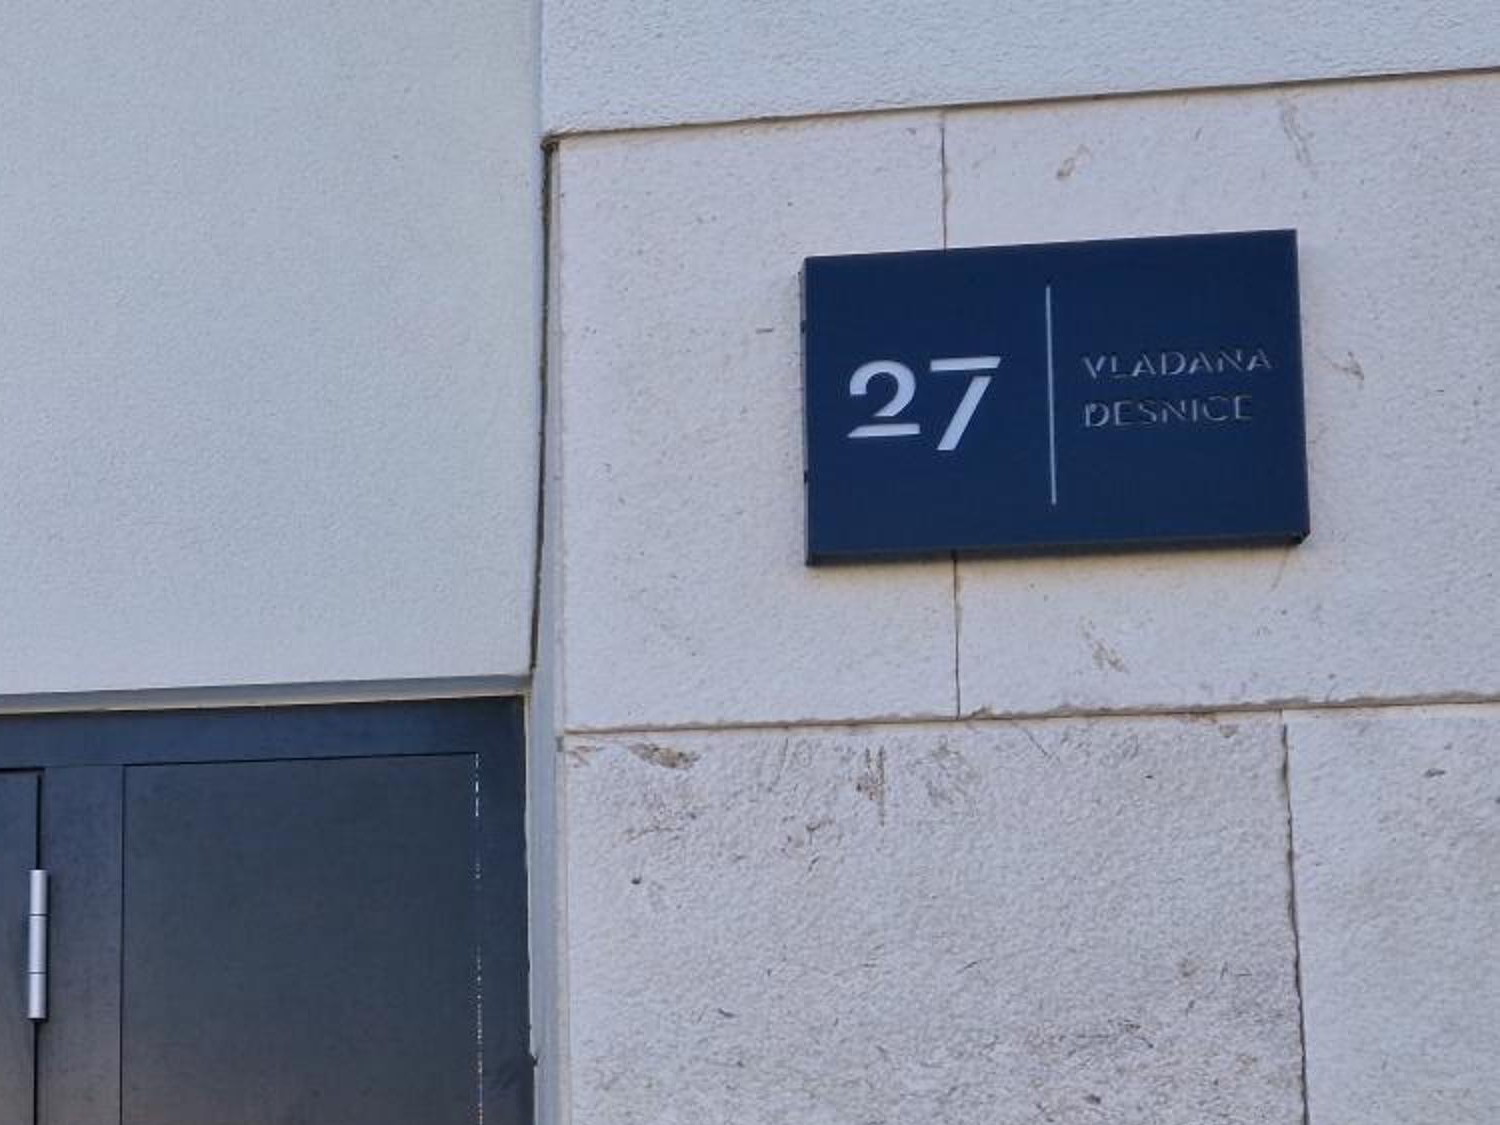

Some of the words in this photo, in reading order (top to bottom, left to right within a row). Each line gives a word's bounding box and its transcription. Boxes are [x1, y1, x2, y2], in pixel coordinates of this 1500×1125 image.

[1083, 348, 1271, 379] VLADANA
[847, 356, 1001, 451] 27
[1084, 396, 1252, 427] DESNICE
